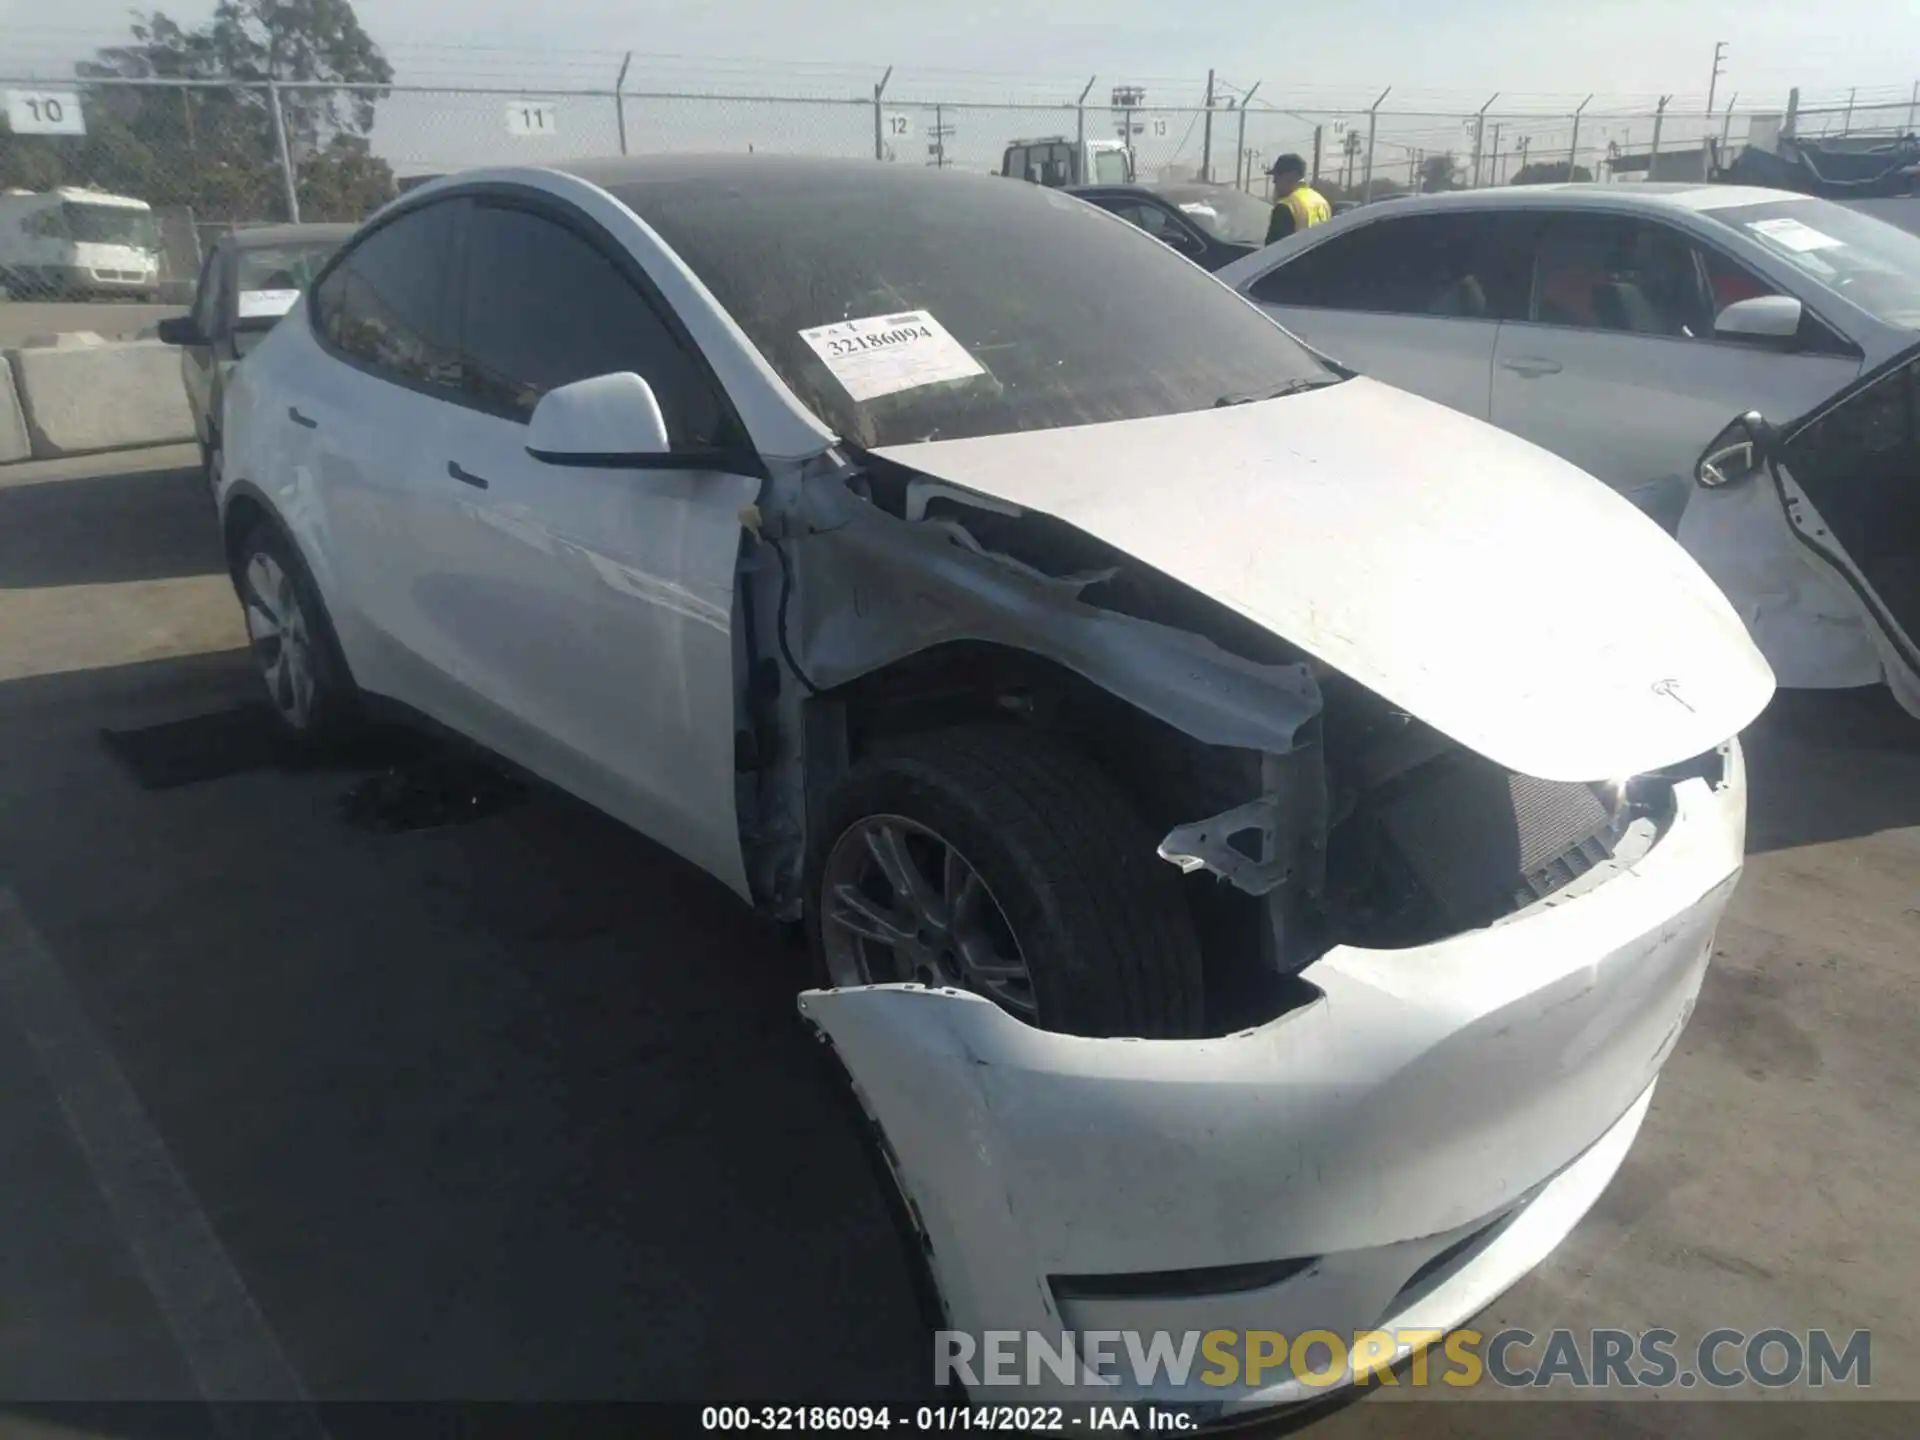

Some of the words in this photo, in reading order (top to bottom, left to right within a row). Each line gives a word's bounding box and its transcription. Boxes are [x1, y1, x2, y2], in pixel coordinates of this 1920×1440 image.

[25, 99, 63, 122] 10
[520, 107, 544, 129] 11
[889, 116, 907, 136] 12
[1153, 120, 1166, 136] 13
[826, 326, 932, 356] 32186094
